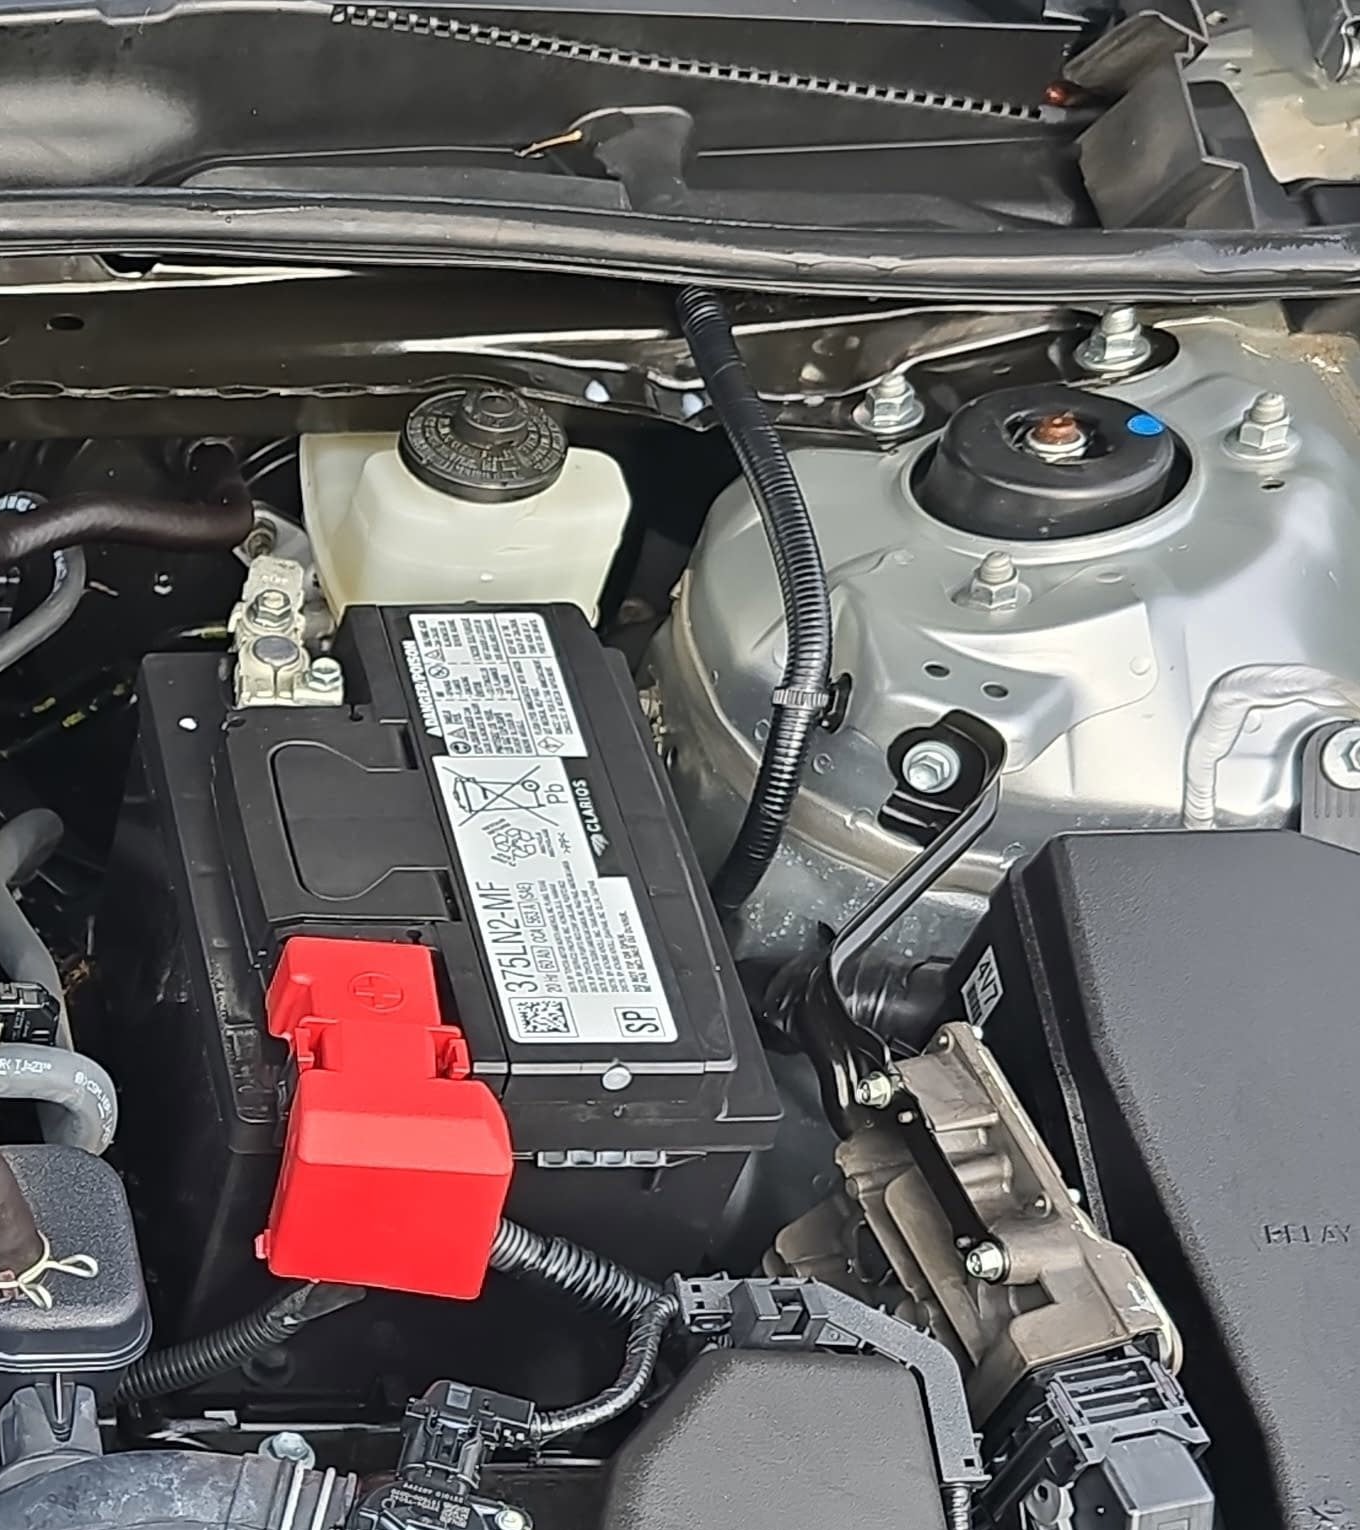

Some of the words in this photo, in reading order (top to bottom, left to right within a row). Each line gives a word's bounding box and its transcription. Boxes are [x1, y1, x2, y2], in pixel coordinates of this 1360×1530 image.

[543, 783, 568, 803] Pb
[571, 779, 602, 832] CLARIOS
[474, 880, 538, 992] 375LN2-MF
[546, 983, 562, 992] 20
[621, 1010, 660, 1032] SP
